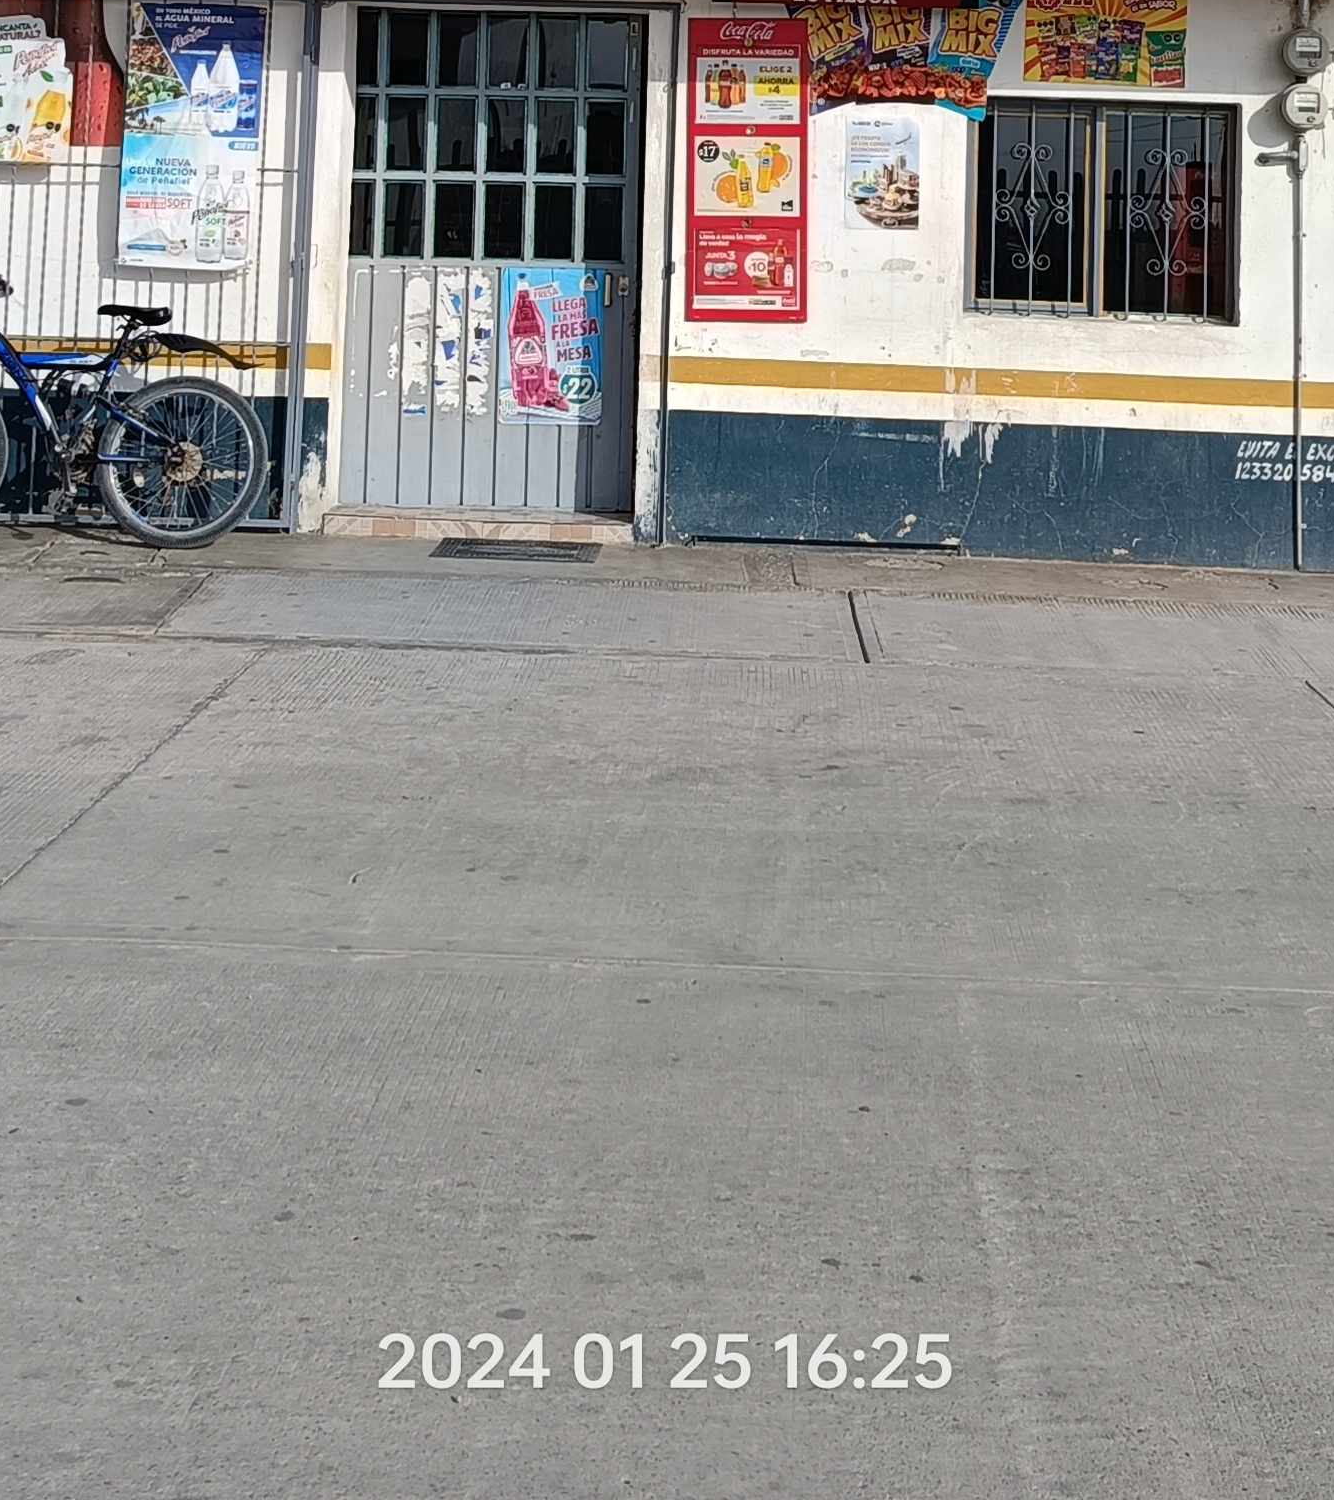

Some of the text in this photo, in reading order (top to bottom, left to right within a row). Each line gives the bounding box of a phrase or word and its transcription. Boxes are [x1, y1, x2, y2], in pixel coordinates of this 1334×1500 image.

[1148, 0, 1176, 10] SABOR
[164, 14, 190, 22] AGUA
[192, 15, 234, 24] MINERAL
[810, 18, 862, 53] MIX
[875, 20, 929, 51] MIX
[940, 8, 1000, 58] BIG MIX
[234, 142, 256, 150] NUEVO
[156, 158, 191, 167] NUEVA
[129, 166, 197, 176] GENERACIÓN
[152, 176, 190, 185] Peñafiel
[168, 198, 192, 208] SOFT
[206, 218, 226, 226] SOFT
[727, 250, 736, 260] 3
[534, 289, 559, 299] FRESA
[552, 298, 586, 312] LLEGA
[558, 313, 568, 322] LA
[552, 318, 599, 340] FRESA
[557, 345, 592, 362] MESA
[562, 378, 592, 399] $22
